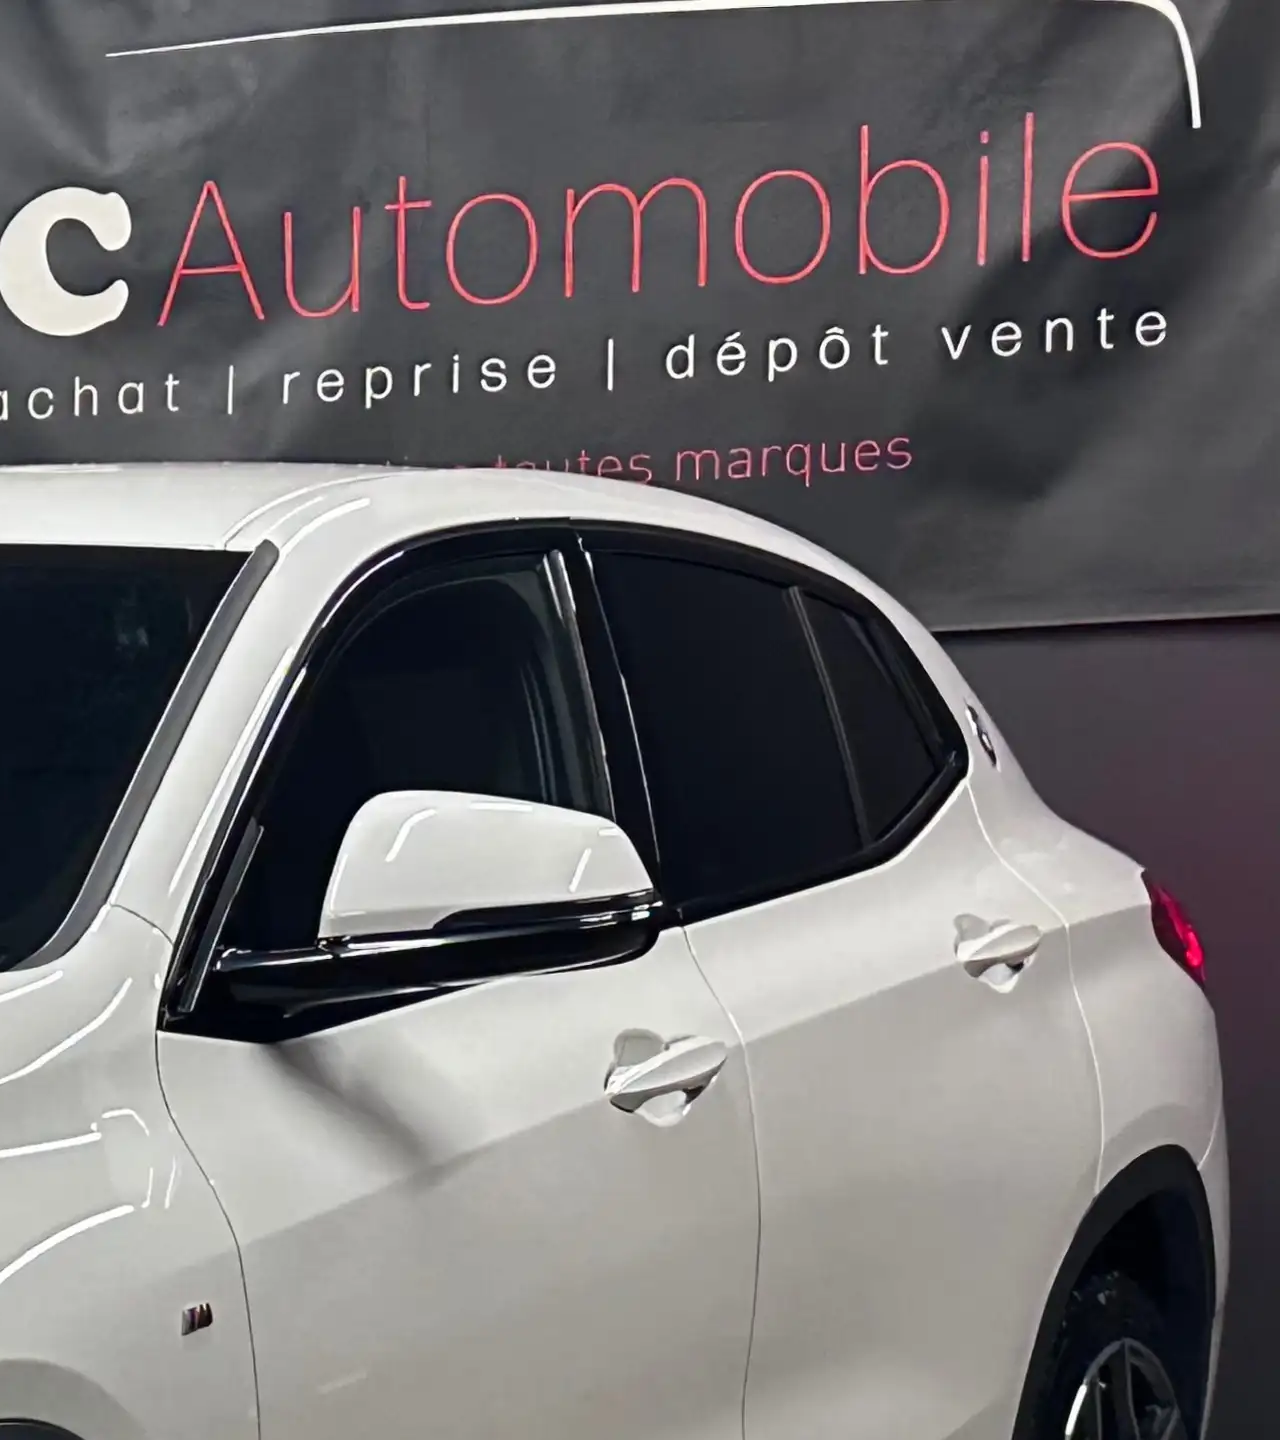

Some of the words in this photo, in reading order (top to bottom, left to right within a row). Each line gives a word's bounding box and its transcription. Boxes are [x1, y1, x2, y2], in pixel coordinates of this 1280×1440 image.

[156, 111, 1159, 327] Automobile
[282, 352, 558, 409] reprise
[664, 323, 890, 383] dépôt
[940, 306, 1168, 362] vente
[494, 449, 653, 485] tes
[675, 436, 914, 488] marques
